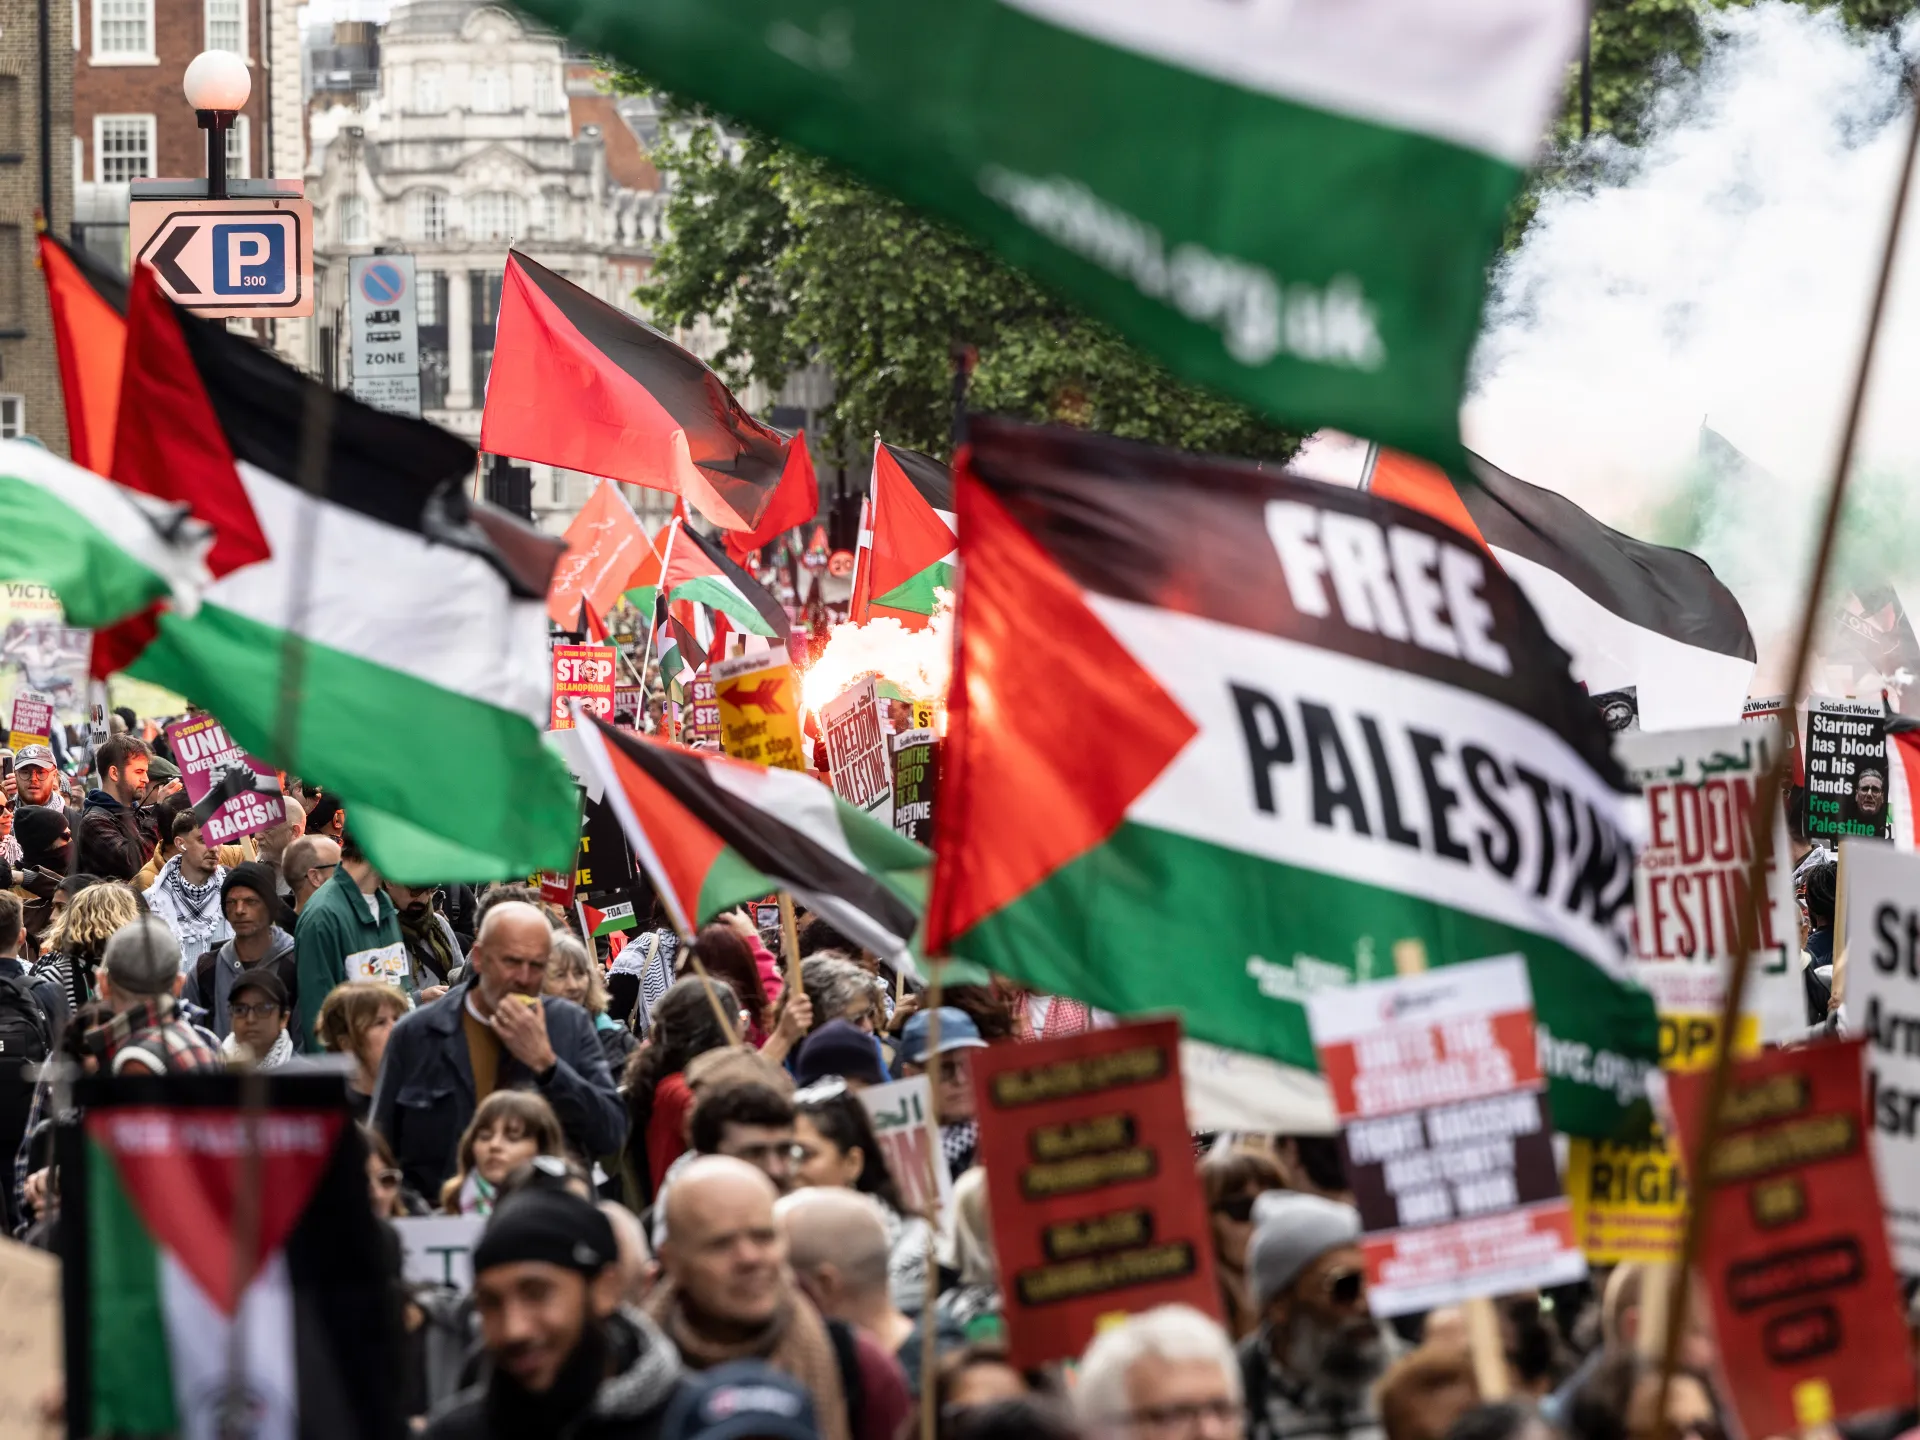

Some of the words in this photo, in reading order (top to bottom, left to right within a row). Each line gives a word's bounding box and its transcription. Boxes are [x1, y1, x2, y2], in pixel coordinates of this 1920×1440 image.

[228, 232, 271, 286] P
[243, 275, 267, 287] 300
[365, 352, 406, 366] ZONE
[1263, 498, 1513, 677] FREE
[556, 683, 611, 692] ISLAMOPHOBIA
[16, 709, 50, 721] AGAINST
[17, 701, 48, 713] WOMEN
[1752, 700, 1781, 711] Worker
[1819, 701, 1852, 714] Socialist
[1852, 705, 1881, 717] Worker
[15, 716, 31, 725] THE
[32, 718, 47, 729] FAR
[183, 722, 205, 736] STAND
[205, 718, 215, 727] UP
[1813, 714, 1875, 737] Starmer
[177, 726, 230, 763] UNI
[828, 701, 882, 773] FREEDOM
[1812, 735, 1836, 753] has
[1840, 737, 1885, 758] blood
[186, 757, 215, 775] OVER
[846, 750, 859, 764] FOR
[1811, 758, 1828, 773] on
[1831, 756, 1856, 776] his
[835, 744, 889, 807] PALESTINE
[1810, 774, 1853, 795] hands
[223, 799, 241, 814] NO
[240, 793, 256, 806] TO
[1809, 794, 1840, 814] Free
[208, 798, 282, 840] RACISM
[1808, 814, 1876, 837] Palestine
[606, 905, 622, 919] FOA
